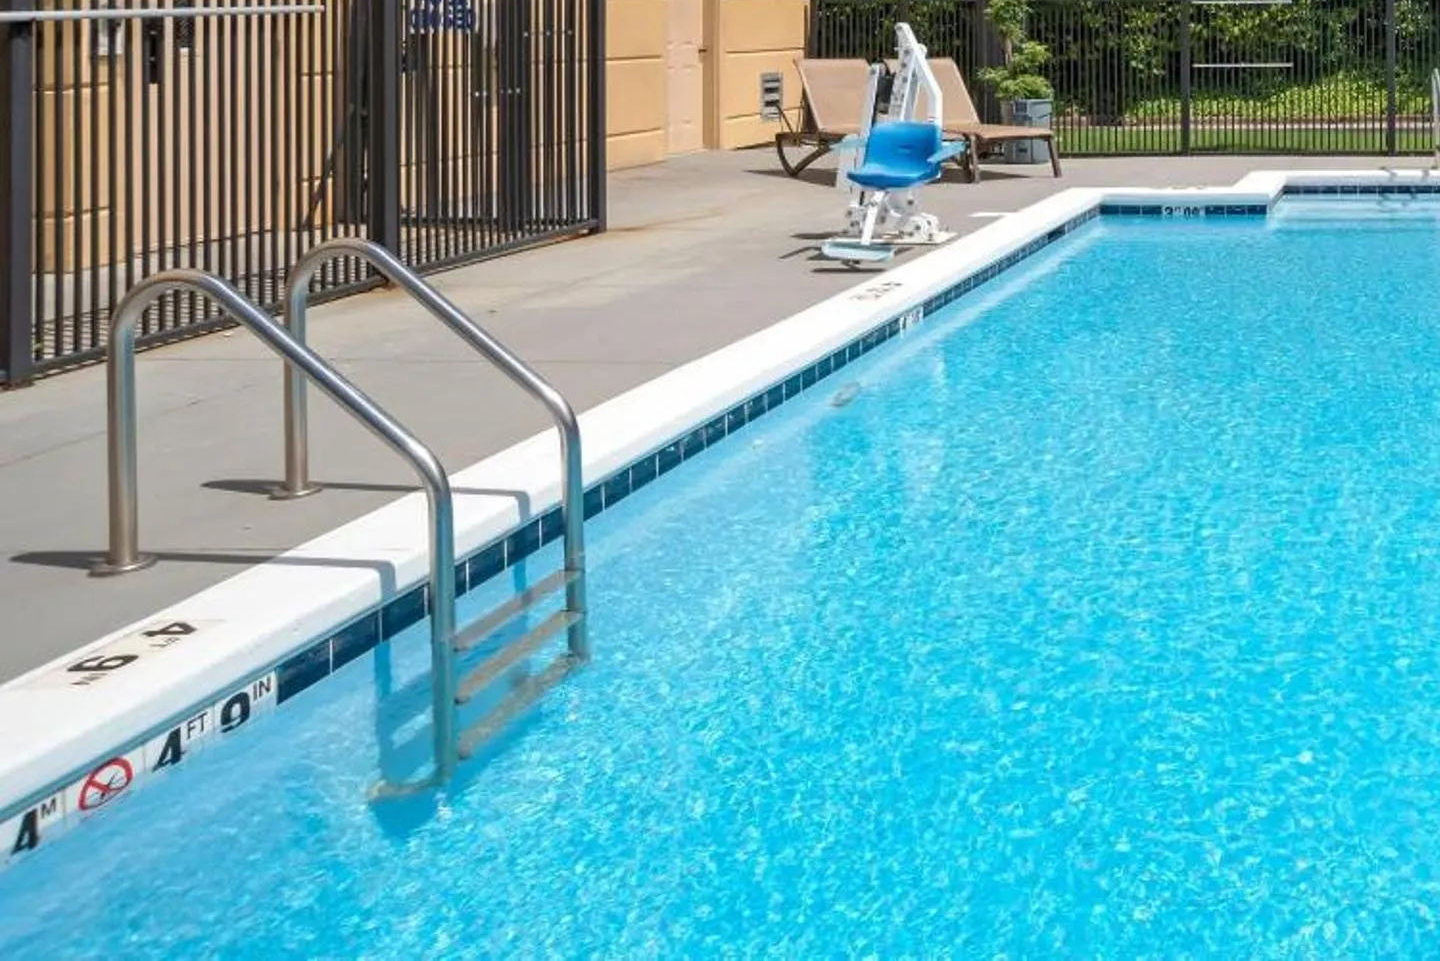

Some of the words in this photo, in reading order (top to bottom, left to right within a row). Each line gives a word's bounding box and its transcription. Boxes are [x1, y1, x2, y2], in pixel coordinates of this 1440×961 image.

[152, 727, 187, 773] 4
[187, 712, 208, 739] FT
[220, 691, 250, 733] 9
[253, 676, 271, 700] IN
